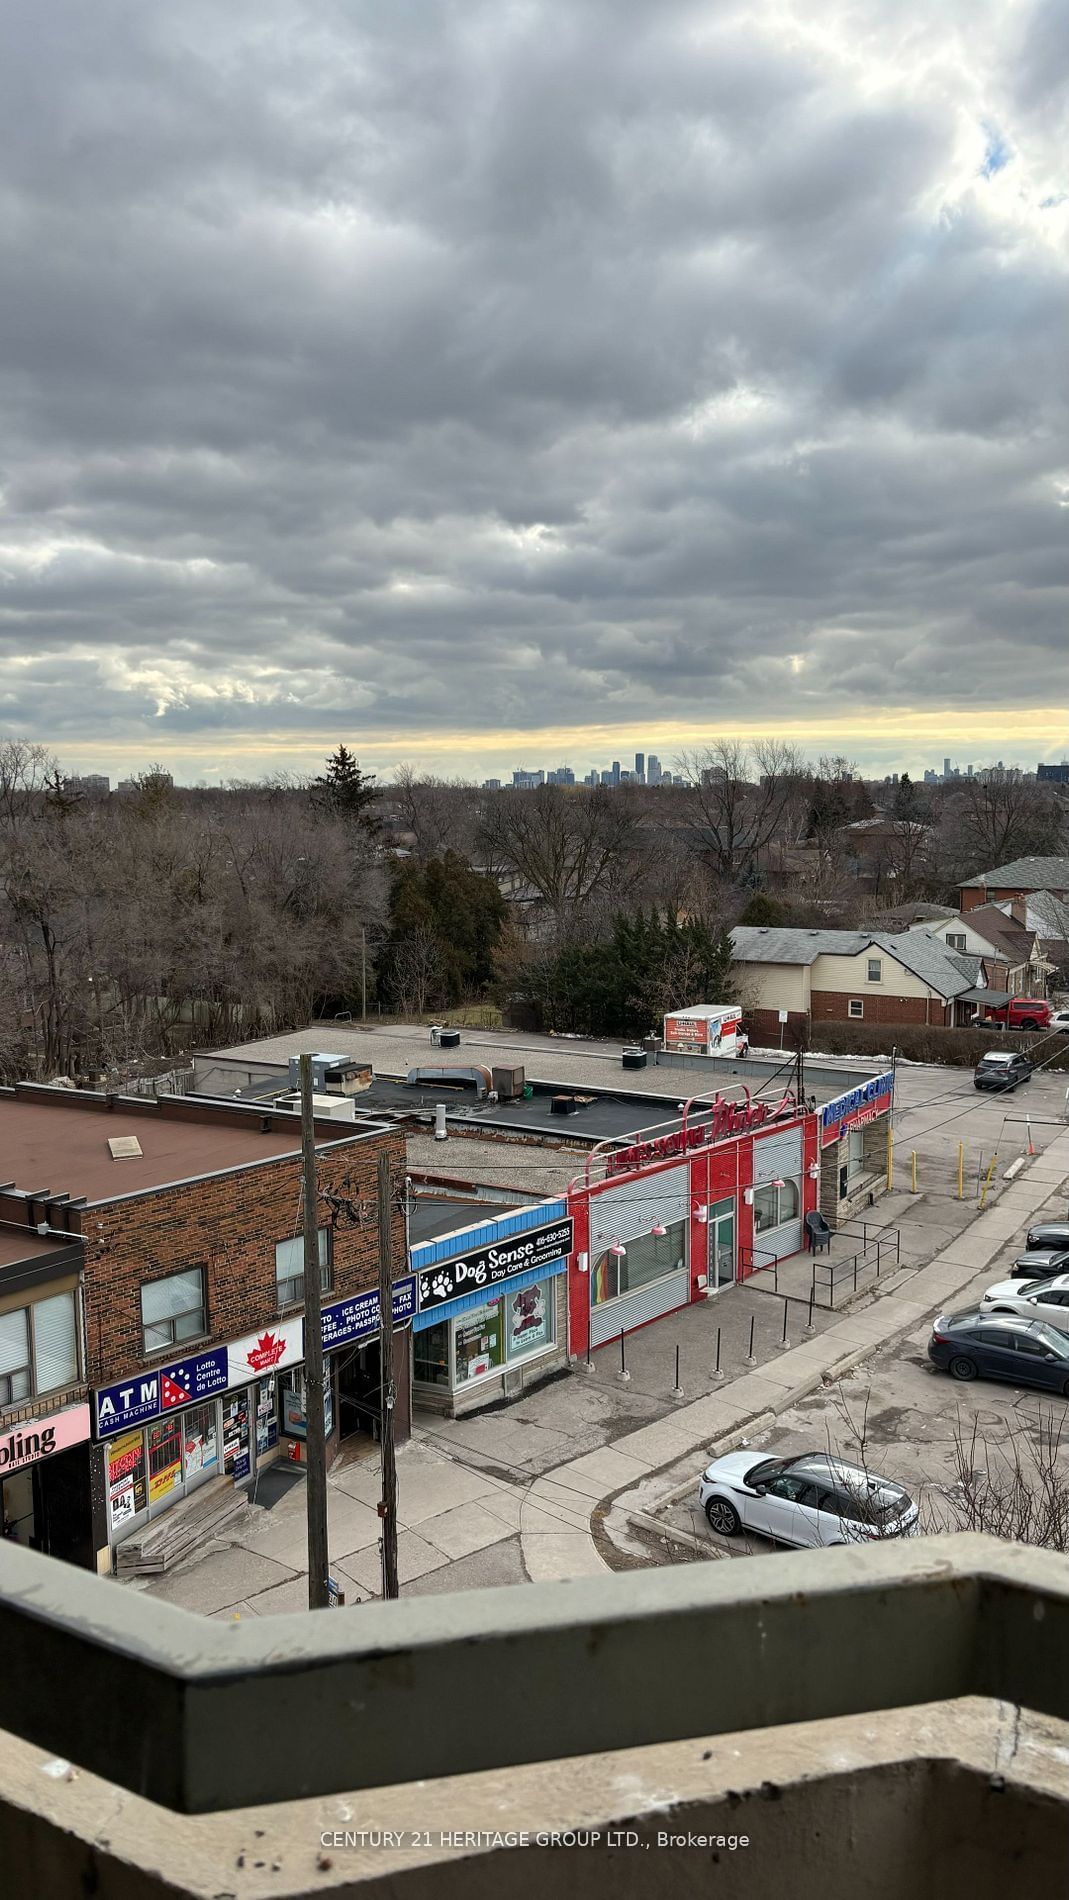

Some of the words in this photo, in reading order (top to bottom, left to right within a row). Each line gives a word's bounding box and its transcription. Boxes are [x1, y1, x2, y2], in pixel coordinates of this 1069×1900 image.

[823, 1089, 865, 1126] MEDICAL
[866, 1072, 893, 1101] CLINIC
[849, 1109, 879, 1130] PHARMACY
[455, 1261, 487, 1284] Dog
[488, 1242, 534, 1269] Sense
[491, 1268, 506, 1280] Day
[506, 1262, 523, 1273] Care
[523, 1258, 530, 1267] &
[530, 1247, 562, 1264] Grooming
[341, 1307, 354, 1317] ICE
[355, 1296, 379, 1311] CREAM
[346, 1310, 370, 1324] PHOTO
[399, 1292, 412, 1304] FAX
[321, 1325, 352, 1342] ERAGES
[355, 1314, 380, 1330] PASSPO
[196, 1360, 216, 1372] Lotto
[250, 1345, 283, 1363] COMPLETE
[196, 1368, 221, 1382] Centre
[196, 1382, 206, 1392] de
[207, 1376, 227, 1388] Lotto
[99, 1380, 158, 1417] ATM
[99, 1416, 120, 1429] CASH
[123, 1402, 158, 1420] MACHINE
